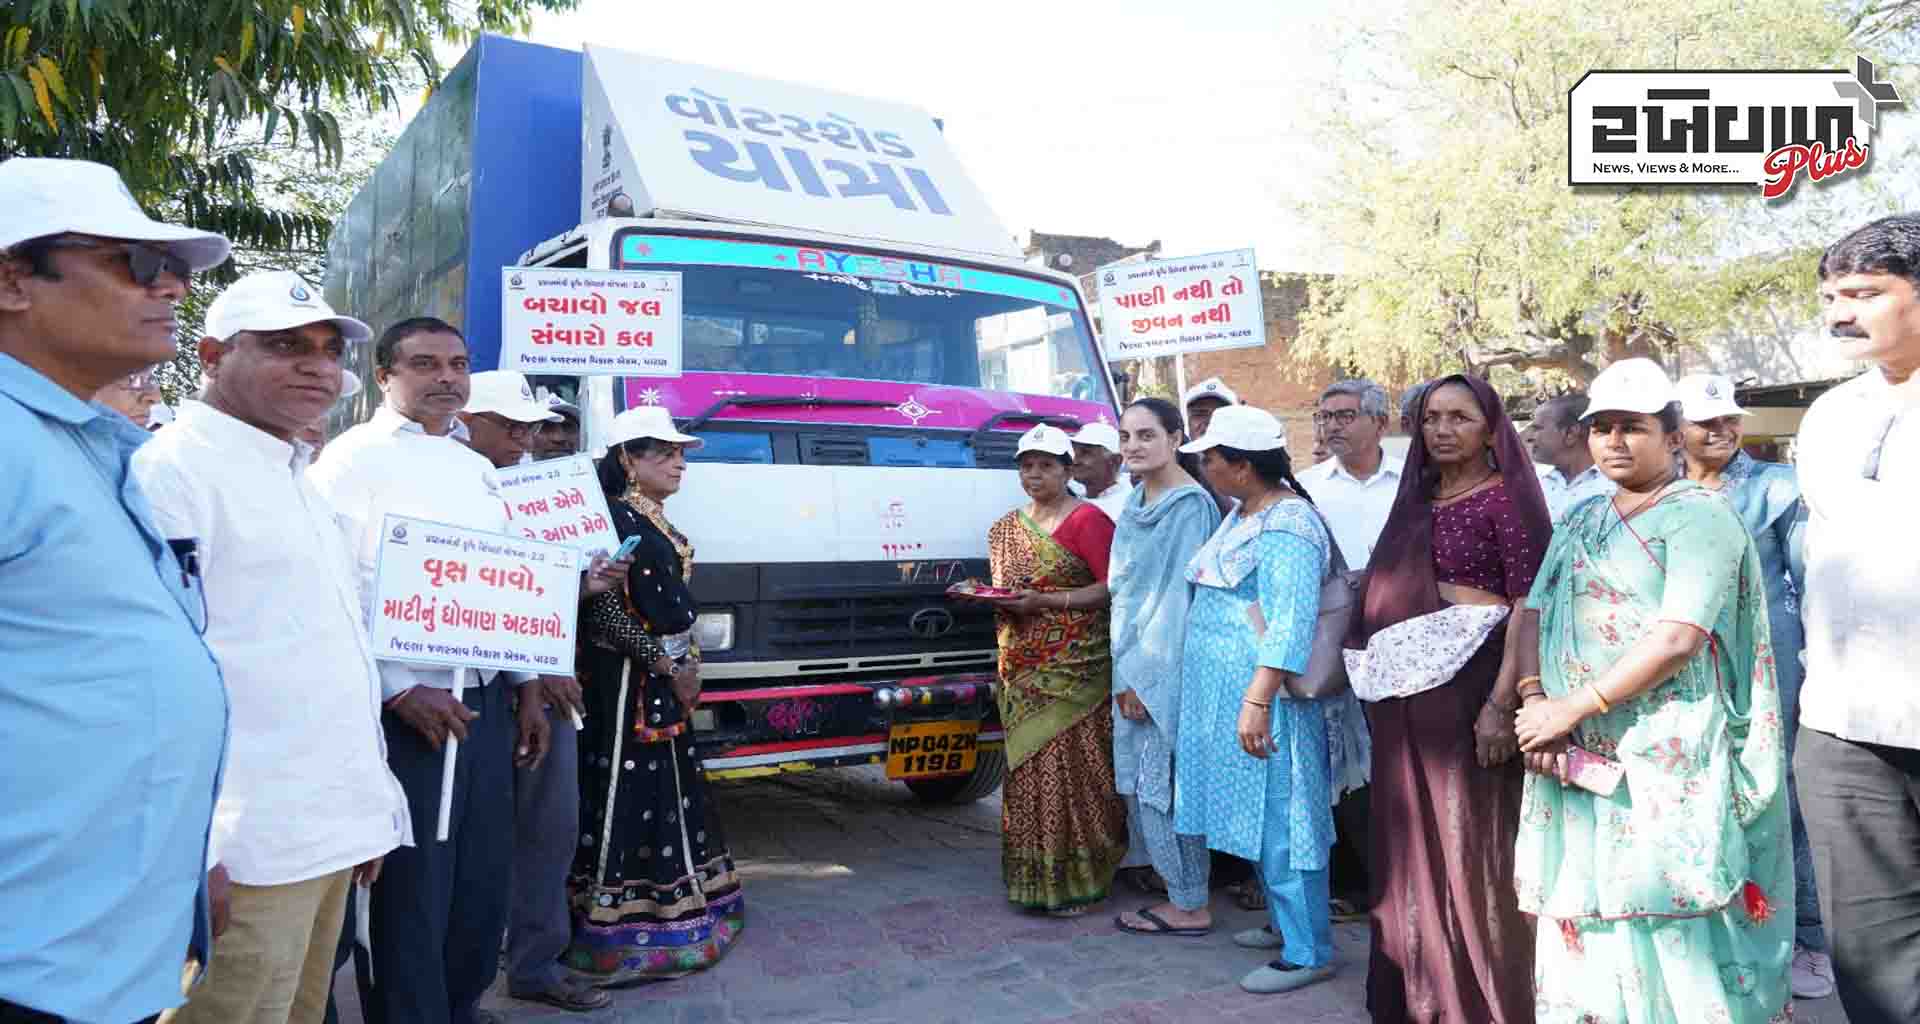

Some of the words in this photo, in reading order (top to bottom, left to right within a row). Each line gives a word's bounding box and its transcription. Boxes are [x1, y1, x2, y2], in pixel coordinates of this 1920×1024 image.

[683, 129, 954, 216] યાત્રા
[797, 248, 964, 288] AYESHA
[523, 293, 608, 315] બચાવો
[618, 300, 661, 316] જલ
[1114, 285, 1165, 308] પાણી
[1173, 280, 1213, 301] નથી
[1222, 275, 1244, 296] તો
[1132, 315, 1184, 333] જીવન
[1191, 303, 1232, 324] નથી
[531, 322, 605, 346] સંવારો
[616, 331, 653, 347] કલ
[518, 499, 549, 516] જાય
[543, 523, 578, 541] આપ
[424, 559, 467, 587] વૃક્ષ
[479, 565, 545, 597] વાવો,
[896, 560, 969, 584] TATA
[384, 594, 437, 631] માટીનું
[502, 612, 567, 639] અટકાવો.
